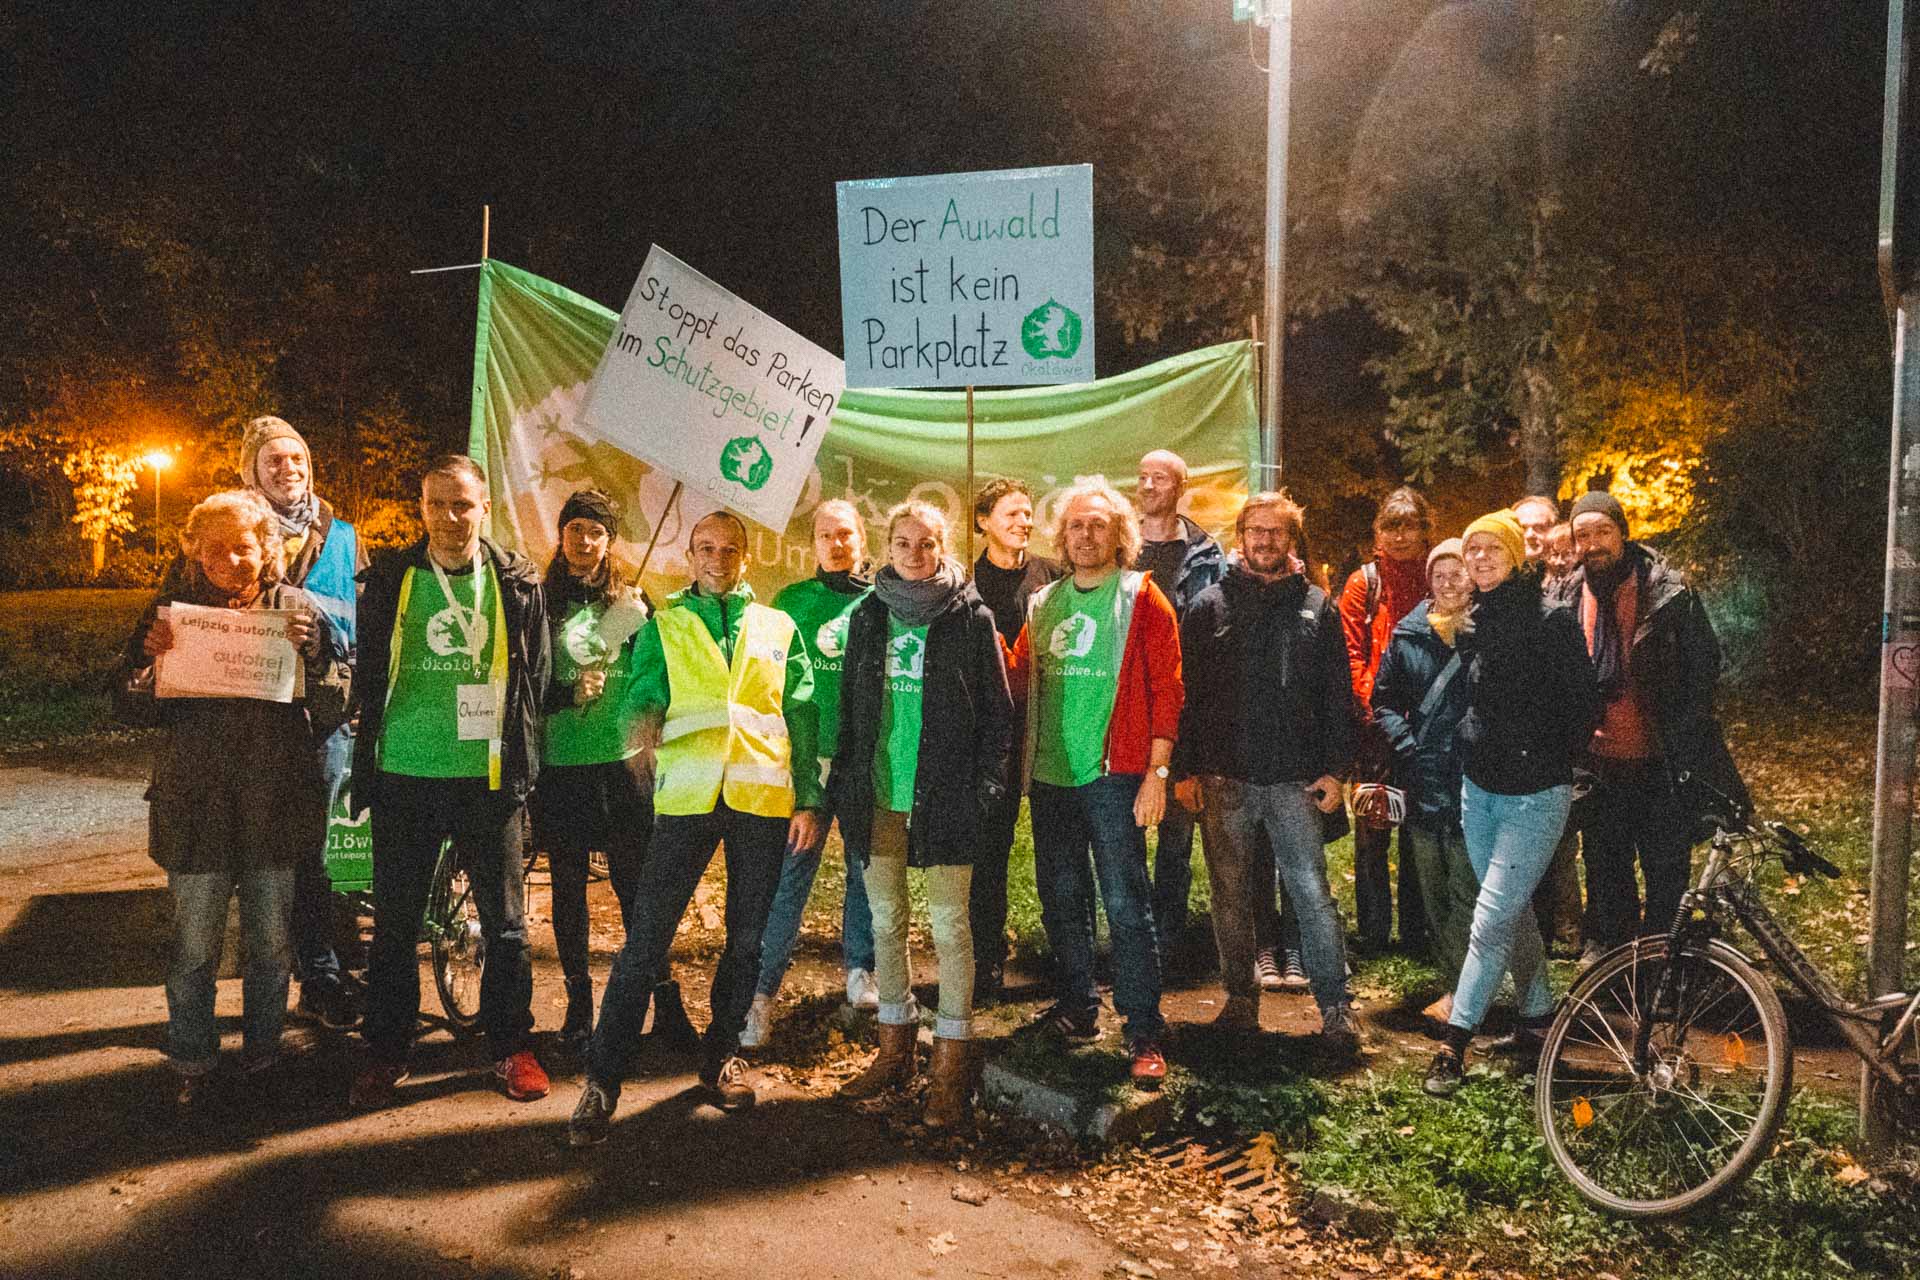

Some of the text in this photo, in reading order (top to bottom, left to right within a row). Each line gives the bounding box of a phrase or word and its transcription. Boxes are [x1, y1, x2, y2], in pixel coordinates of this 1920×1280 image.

[860, 187, 1060, 245] Der Auwald
[891, 256, 1019, 303] ist kein
[616, 323, 643, 356] im
[640, 276, 834, 416] Stoppt das Parken
[861, 311, 1009, 379] Parkplatz
[180, 616, 288, 639] Leipzig autofre
